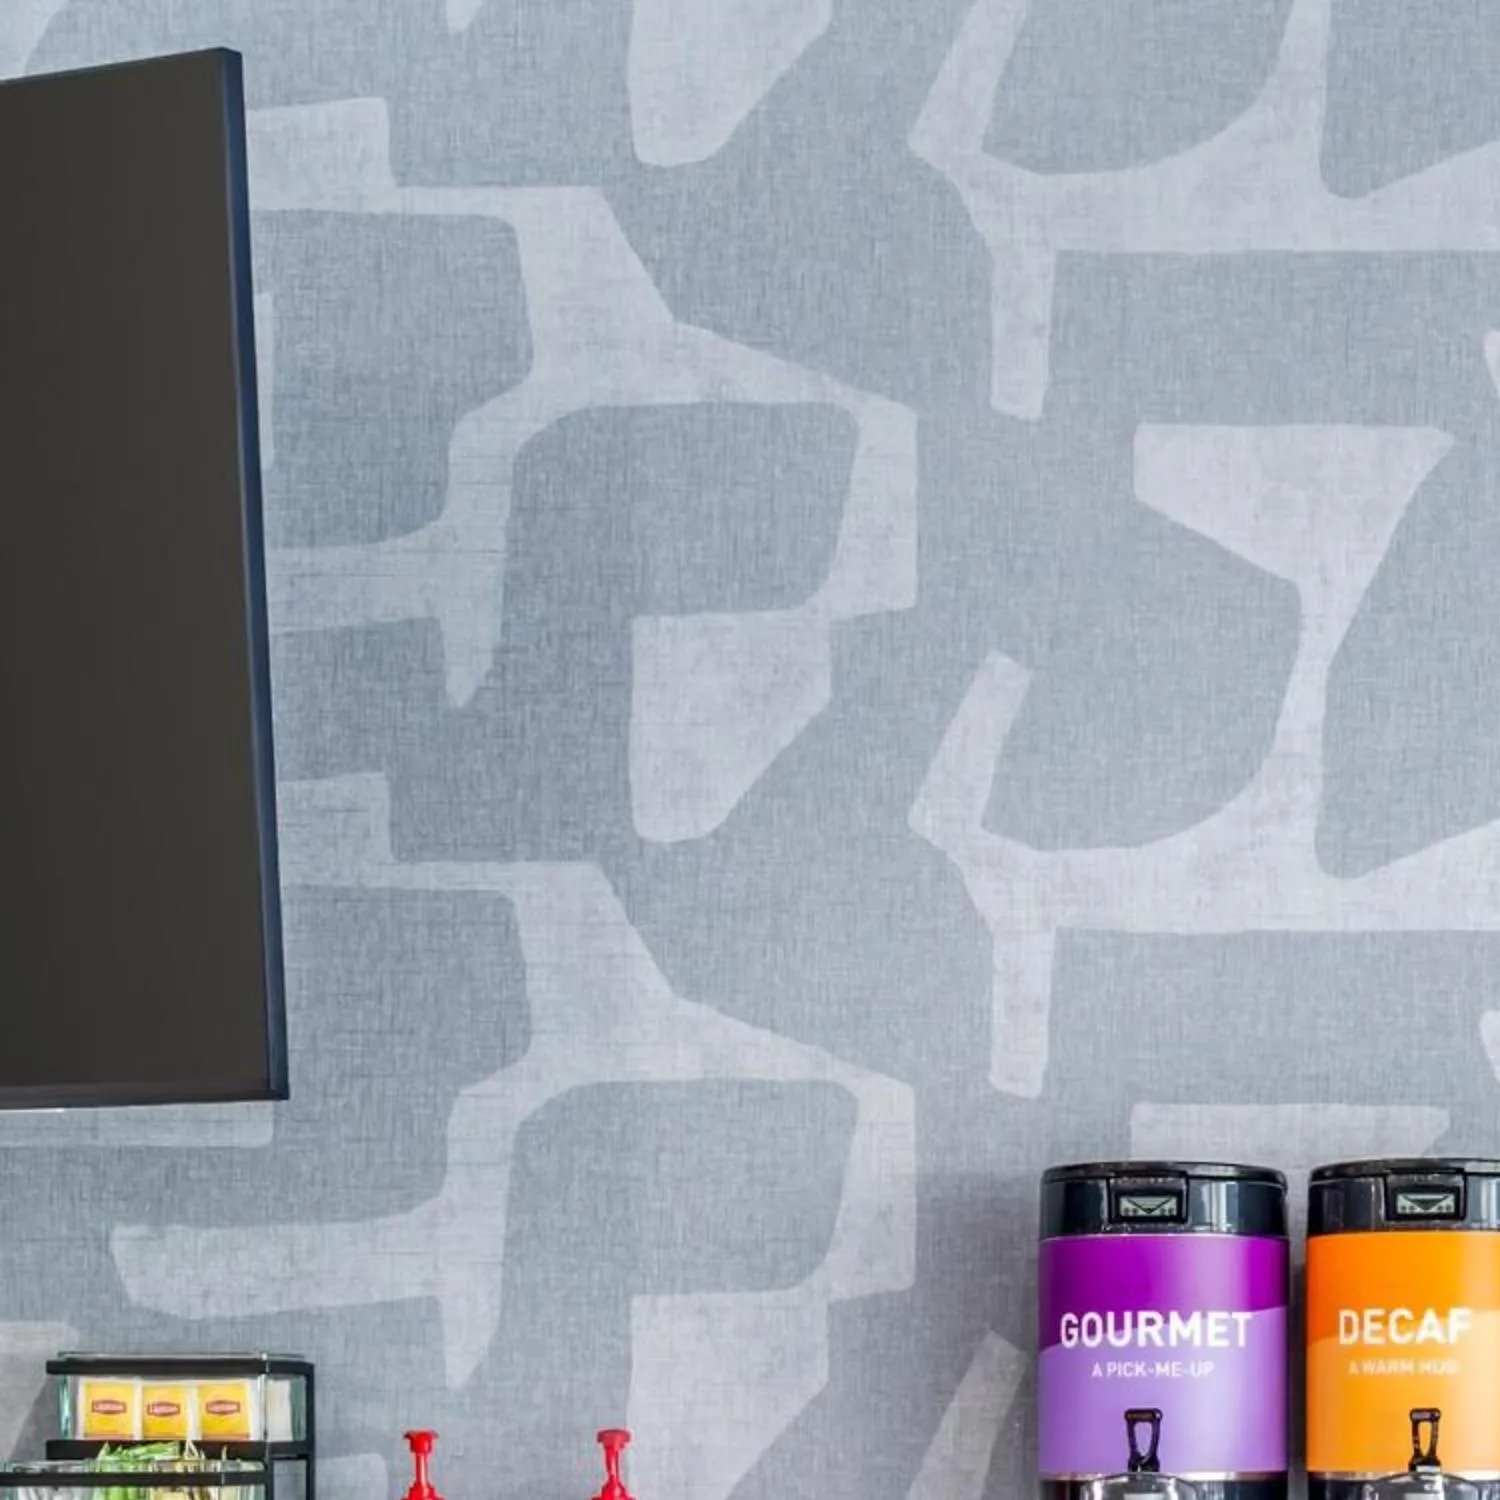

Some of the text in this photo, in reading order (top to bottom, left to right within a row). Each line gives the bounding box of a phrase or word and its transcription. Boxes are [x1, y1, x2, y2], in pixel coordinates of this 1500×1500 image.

[1060, 1311, 1253, 1348] GOURMET
[1338, 1308, 1471, 1345] DECAF
[1091, 1361, 1215, 1378] A PICK-ME-UP
[1348, 1361, 1359, 1376] A
[1362, 1359, 1414, 1377] WARM
